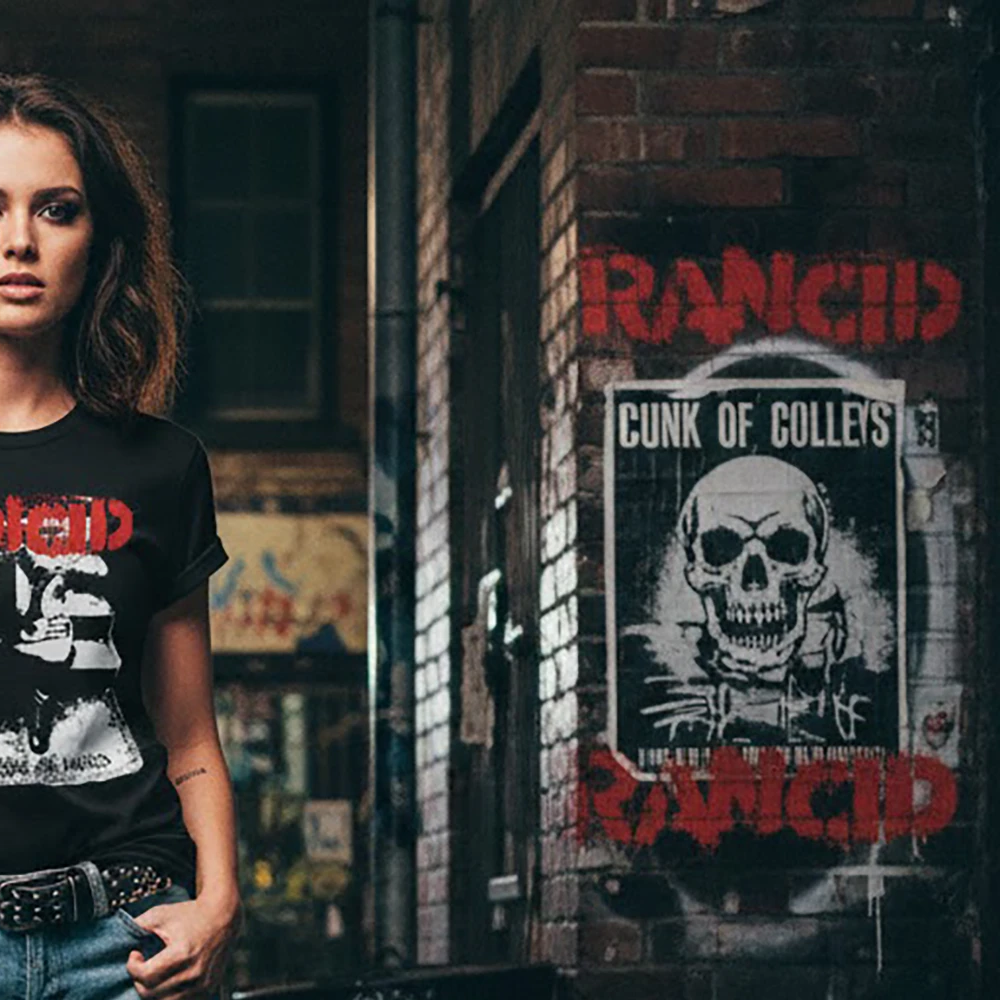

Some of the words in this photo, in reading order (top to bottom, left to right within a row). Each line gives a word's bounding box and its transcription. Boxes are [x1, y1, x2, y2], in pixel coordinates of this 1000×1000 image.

[579, 245, 962, 345] RANCID
[618, 401, 702, 448] CUNK
[718, 401, 753, 448] OF
